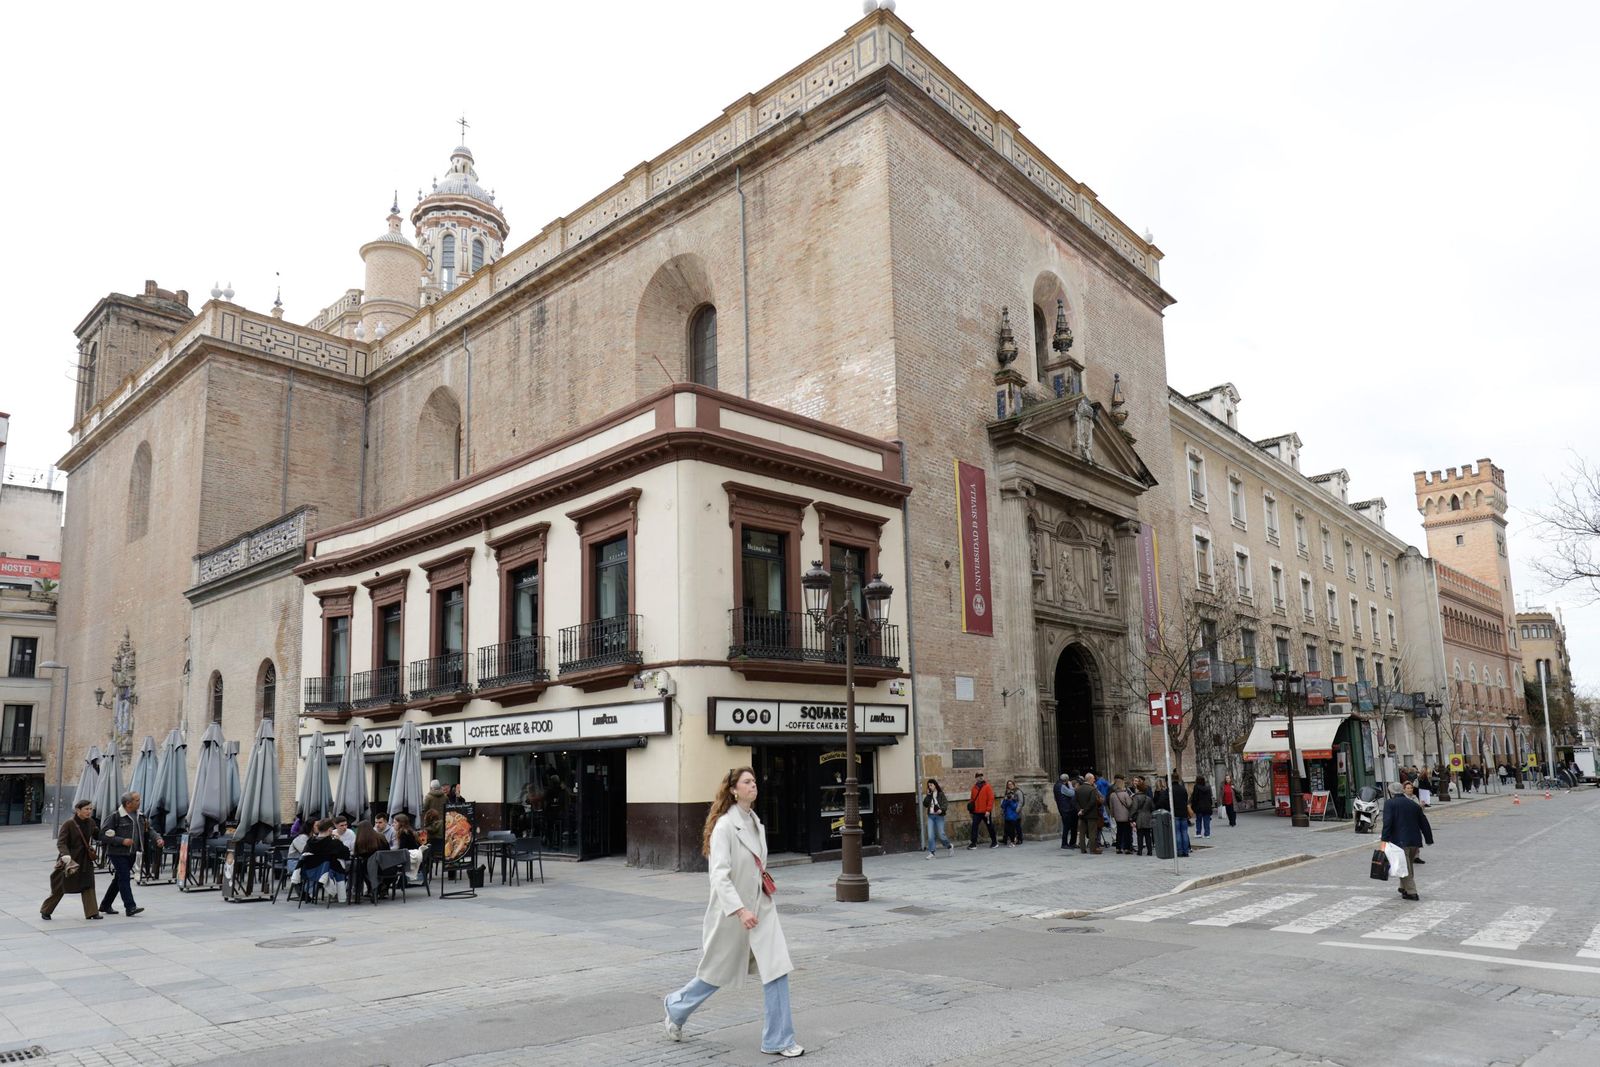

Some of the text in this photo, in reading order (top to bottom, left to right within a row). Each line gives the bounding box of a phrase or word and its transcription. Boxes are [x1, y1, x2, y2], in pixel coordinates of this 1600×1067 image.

[970, 483, 978, 520] SEVILLA
[973, 530, 982, 591] UNIVERSIDAD
[1, 563, 32, 574] HOSTEL
[592, 713, 617, 725] LAVAZZA
[800, 706, 847, 720] SQUARE
[870, 712, 895, 723] LAVAZZA
[501, 722, 522, 735] CAKE
[523, 722, 530, 734] &
[531, 720, 553, 733] FOOD
[816, 722, 833, 730] CAKE
[835, 722, 840, 730] &
